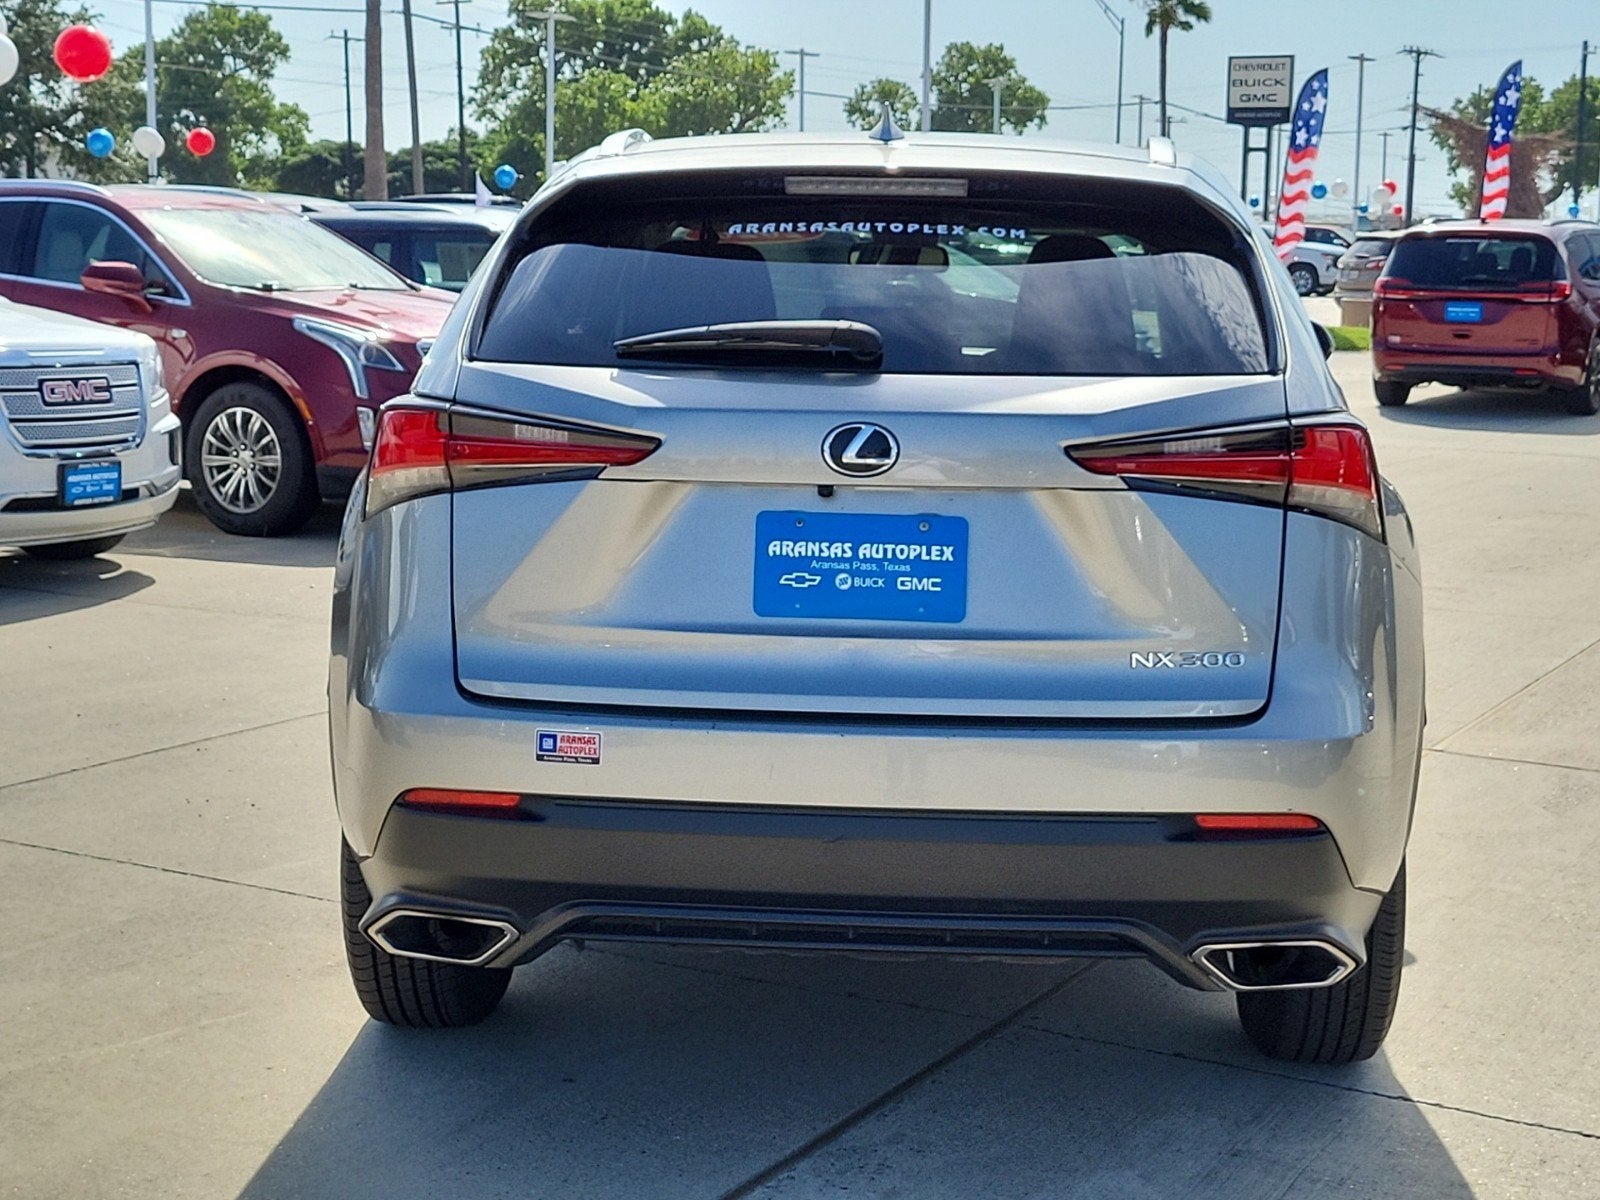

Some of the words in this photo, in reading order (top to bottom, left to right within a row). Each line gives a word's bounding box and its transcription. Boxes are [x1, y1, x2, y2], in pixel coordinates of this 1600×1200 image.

[1232, 62, 1286, 72] CHEVROLET
[1232, 78, 1287, 87] BUICK
[1240, 93, 1278, 102] GMC
[43, 380, 110, 402] GMC
[768, 540, 852, 558] ARANSAS
[858, 543, 954, 561] AUTOPLEX
[810, 560, 850, 570] Aransas
[853, 561, 879, 572] Pass,
[884, 562, 911, 572] Texas
[854, 577, 885, 588] BUICK
[897, 577, 942, 591] GMC
[560, 735, 596, 745] ARANSAS
[558, 745, 598, 756] AUTOPLEX
